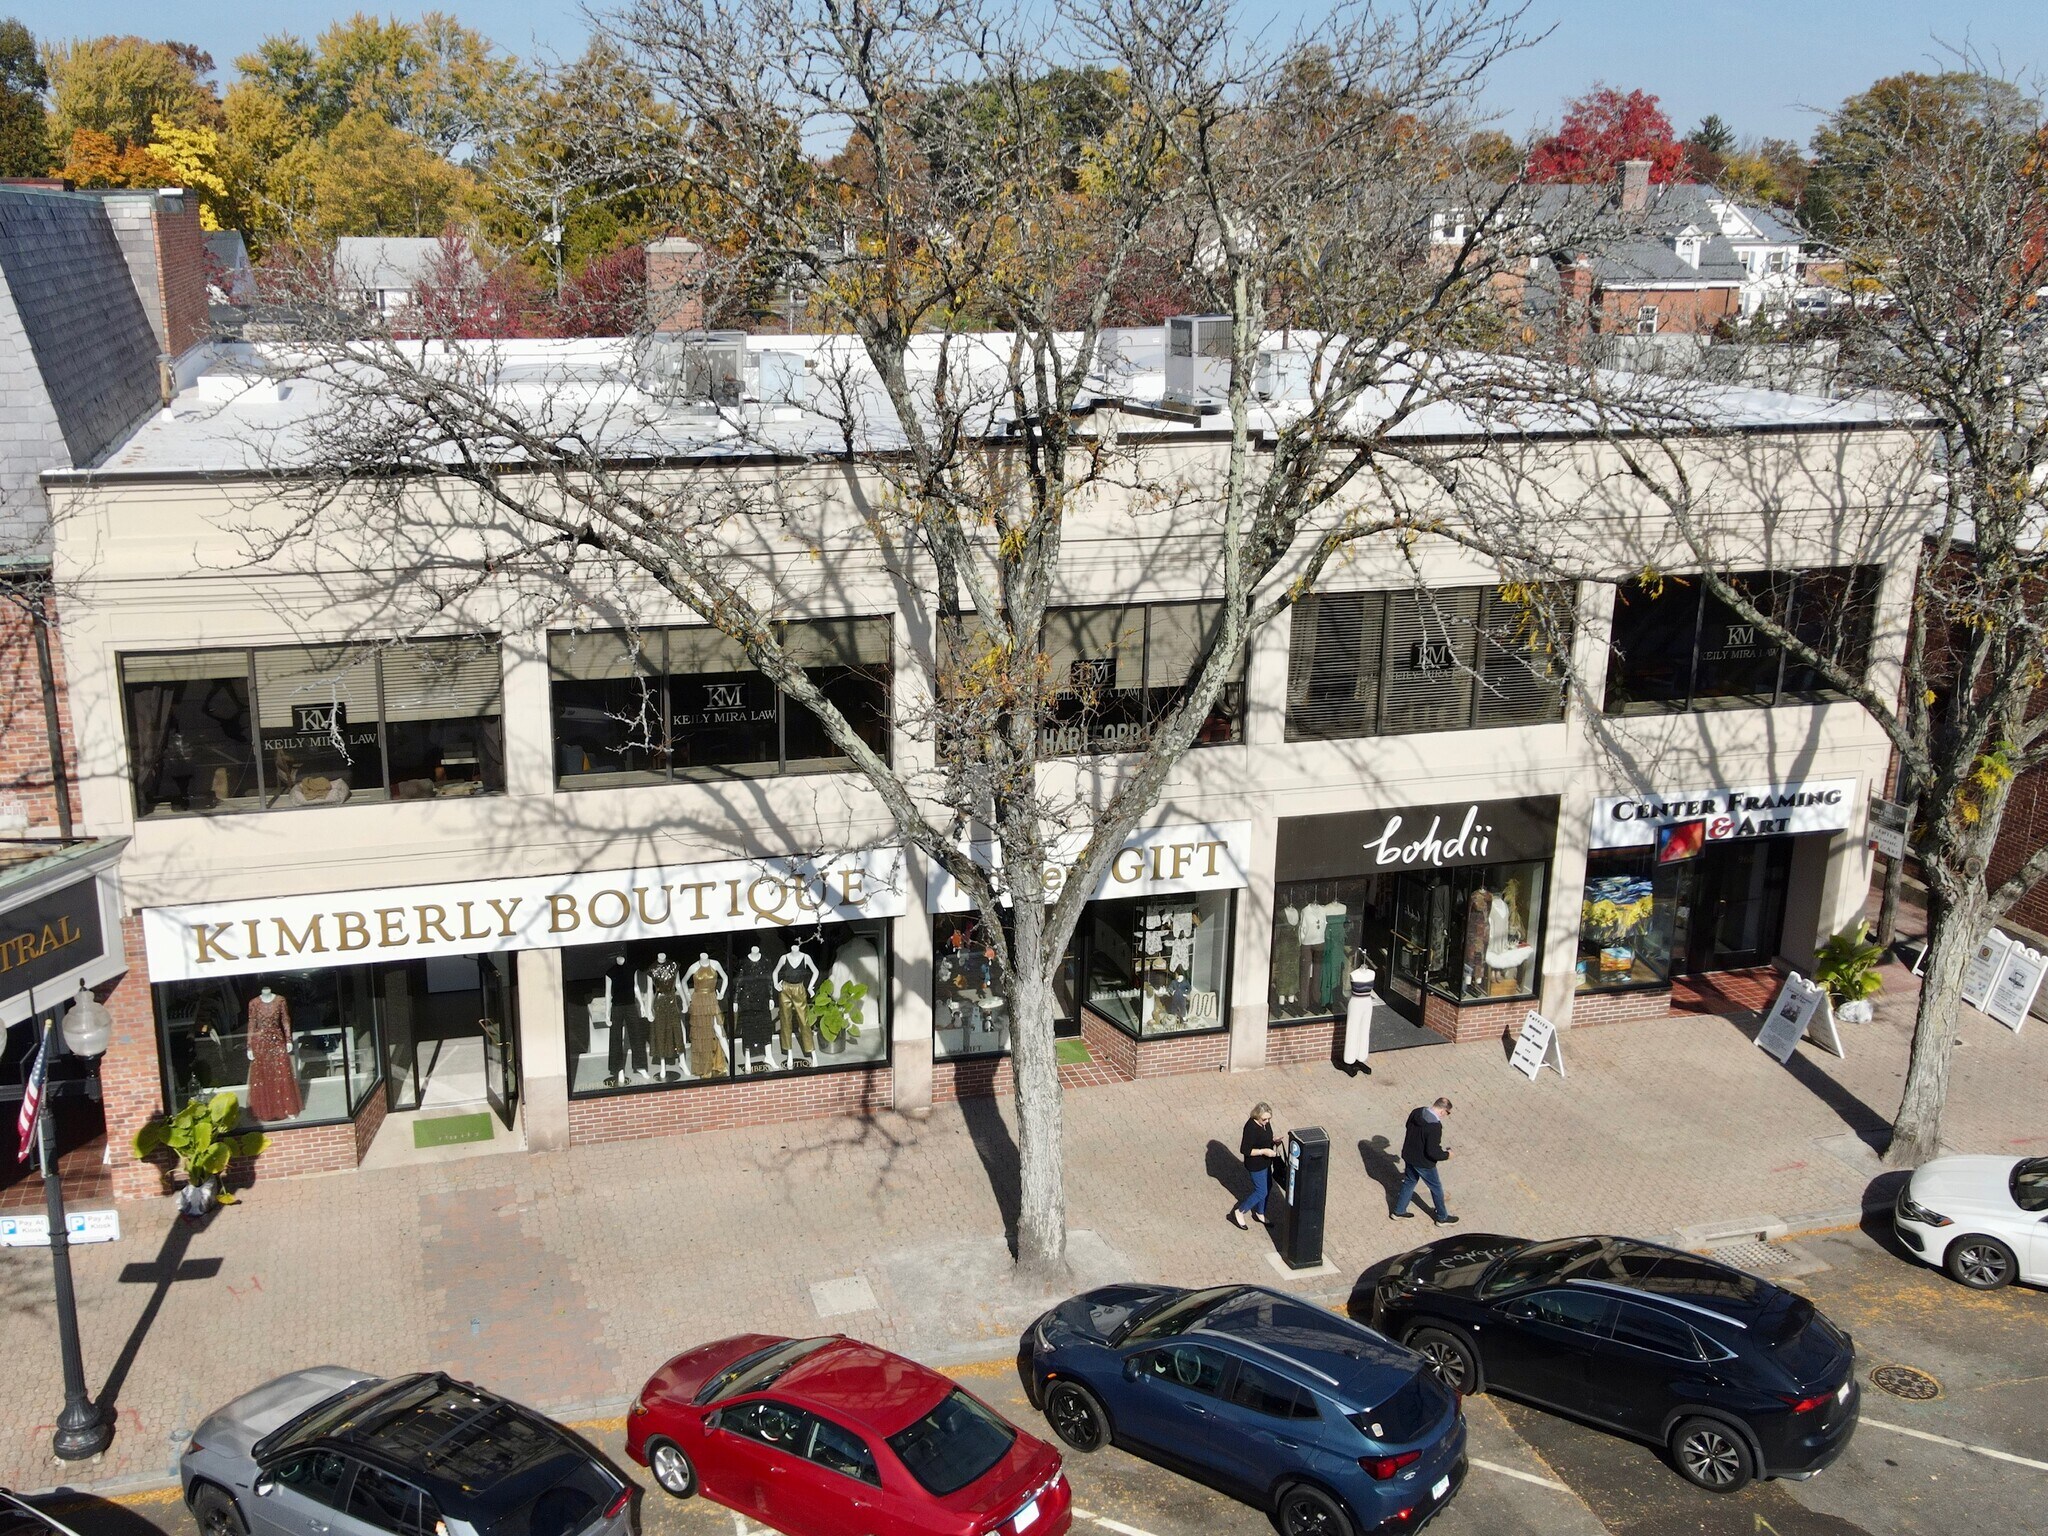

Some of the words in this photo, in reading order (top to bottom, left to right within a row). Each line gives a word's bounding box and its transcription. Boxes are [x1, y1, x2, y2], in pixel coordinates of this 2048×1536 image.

[1731, 649, 1756, 659] MIRA
[706, 685, 743, 707] KM
[673, 713, 711, 726] KEILY
[715, 711, 748, 723] MIRA
[751, 709, 776, 721] LAW
[264, 737, 305, 751] KEILY
[350, 733, 377, 745] LAW
[1362, 805, 1492, 866] bohdii
[1112, 840, 1228, 884] GIFT
[190, 897, 523, 964] KIMBERLY
[544, 868, 867, 933] BOUTIQUE
